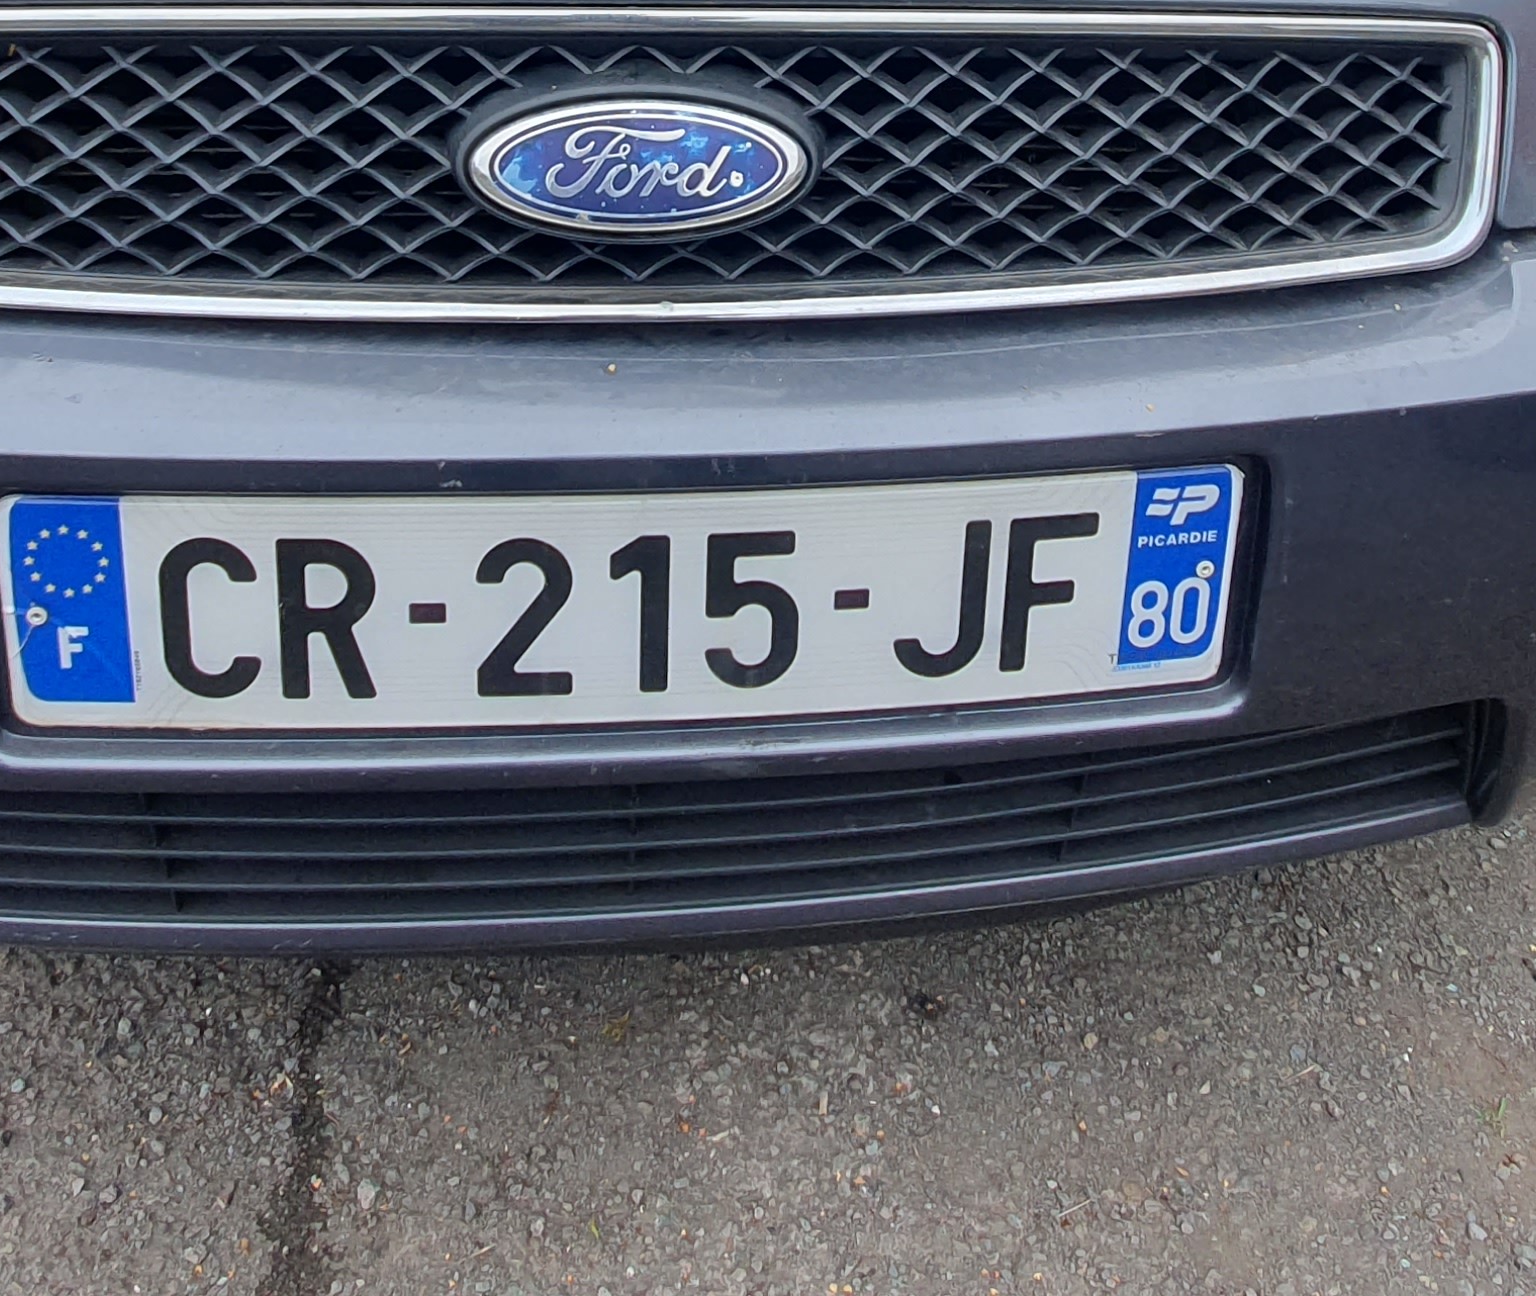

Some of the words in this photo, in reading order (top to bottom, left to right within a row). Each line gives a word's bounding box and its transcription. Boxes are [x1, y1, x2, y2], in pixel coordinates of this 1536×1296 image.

[545, 125, 732, 197] Ford
[1137, 530, 1218, 548] PICARDIE
[157, 512, 1100, 700] CR-215-JF
[1128, 577, 1211, 648] 80
[57, 626, 89, 670] F
